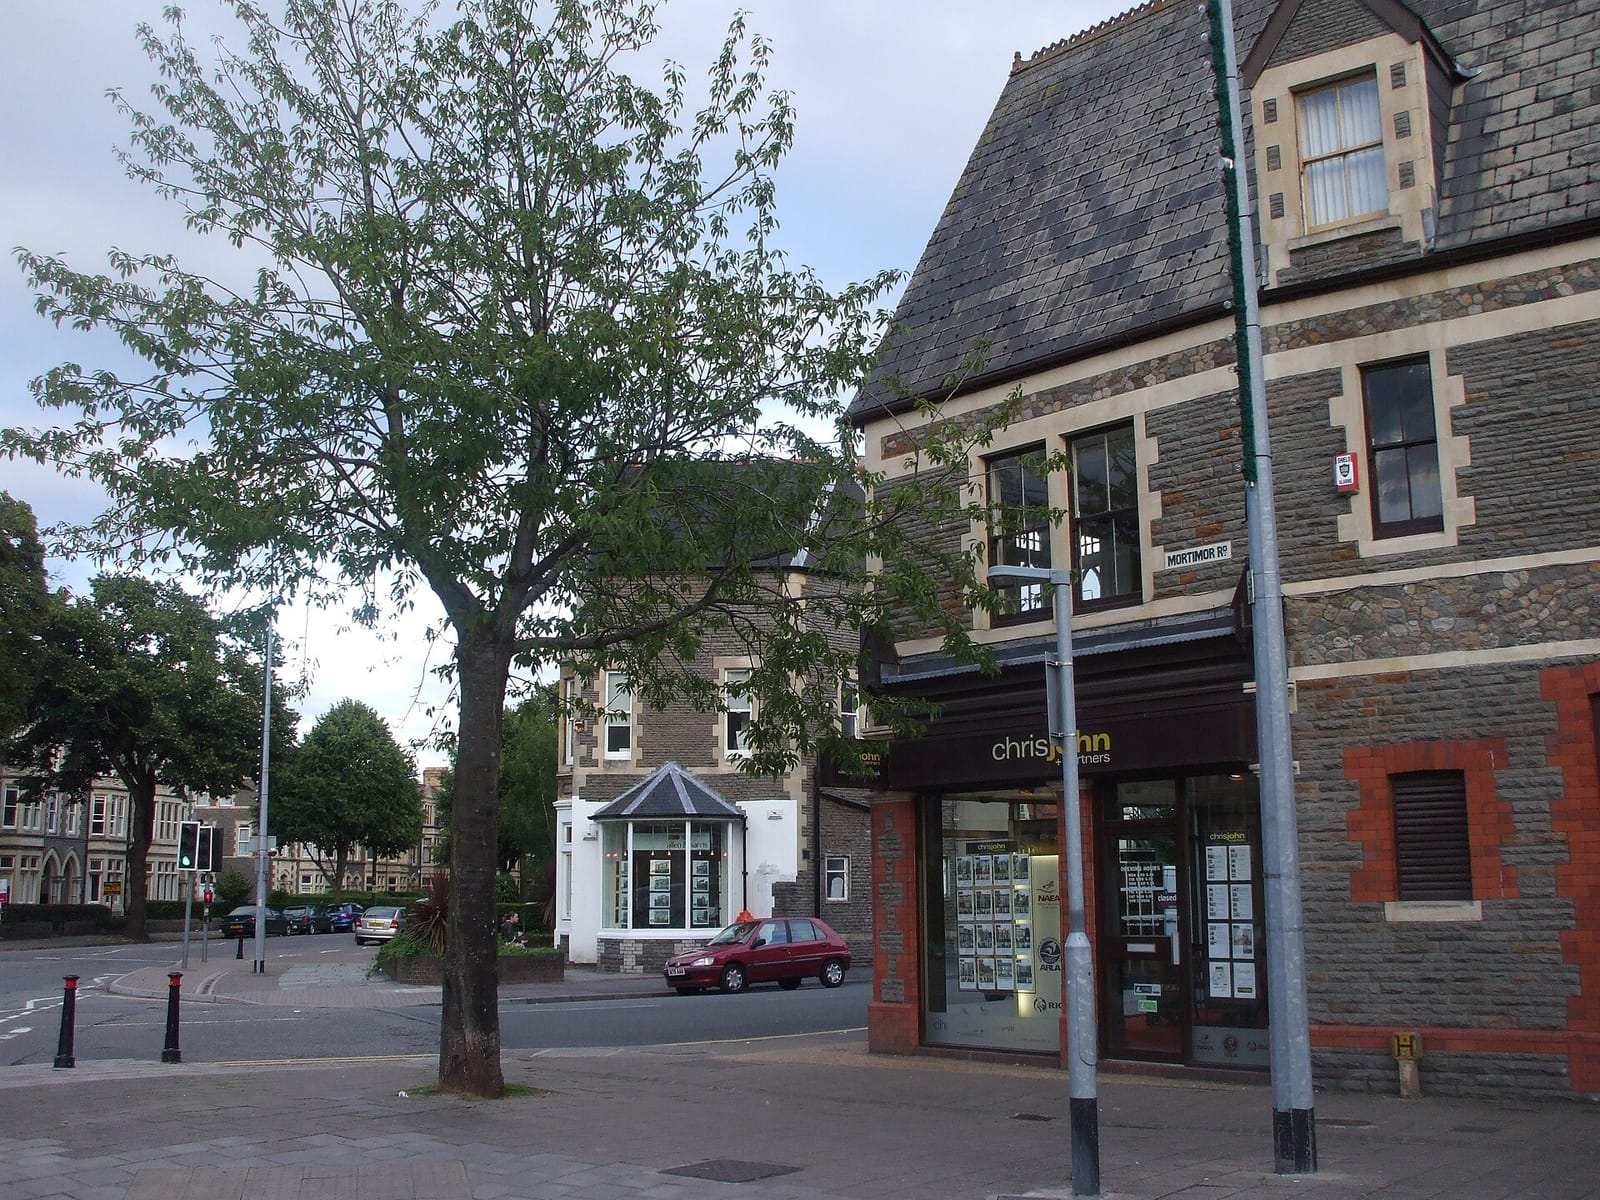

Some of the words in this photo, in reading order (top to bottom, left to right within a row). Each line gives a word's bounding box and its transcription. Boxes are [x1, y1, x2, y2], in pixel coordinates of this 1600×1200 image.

[1167, 548, 1215, 567] MORTIMOR
[992, 729, 1110, 761] chrisjhn
[1209, 832, 1246, 842] chrisjohn
[1157, 893, 1177, 902] closed
